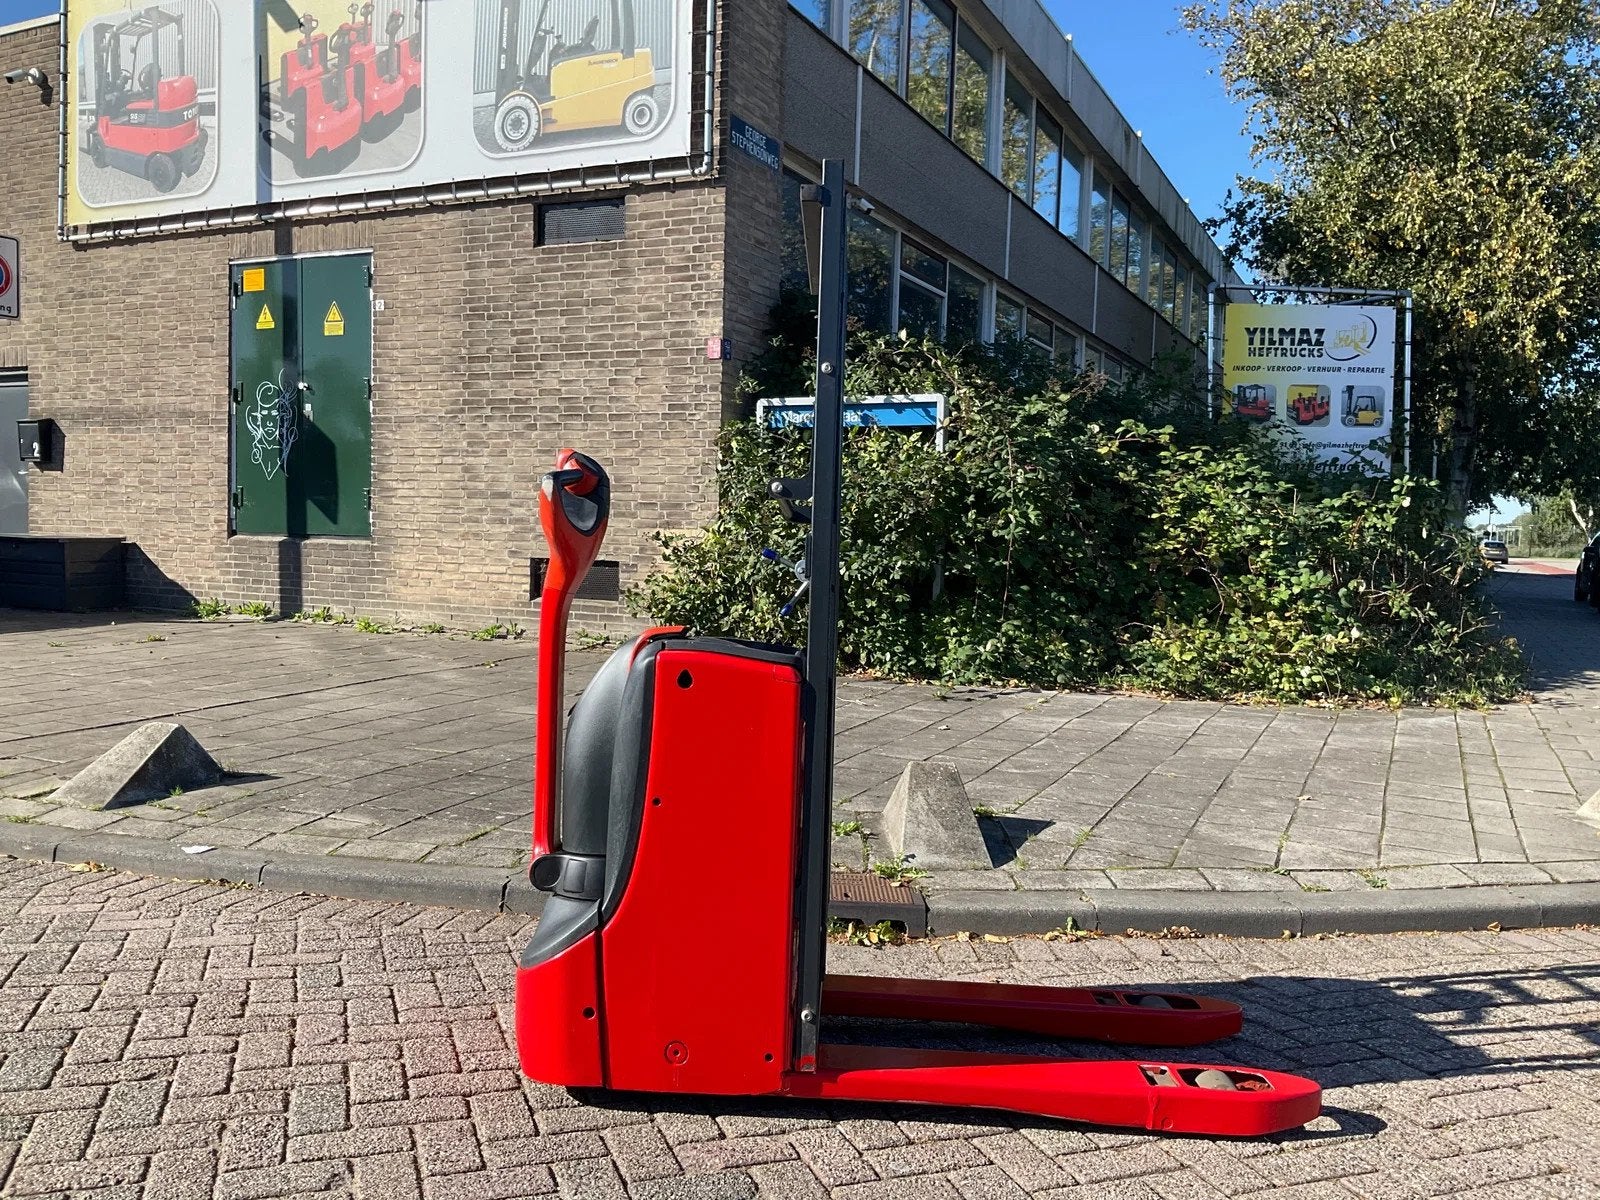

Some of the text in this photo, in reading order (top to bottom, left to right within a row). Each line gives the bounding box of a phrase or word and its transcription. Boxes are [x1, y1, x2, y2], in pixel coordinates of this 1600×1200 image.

[1244, 327, 1326, 347] YILMAZ
[1248, 347, 1324, 358] HEFTRUCKS
[1347, 366, 1386, 374] REPARATIE
[32, 442, 40, 457] 2
